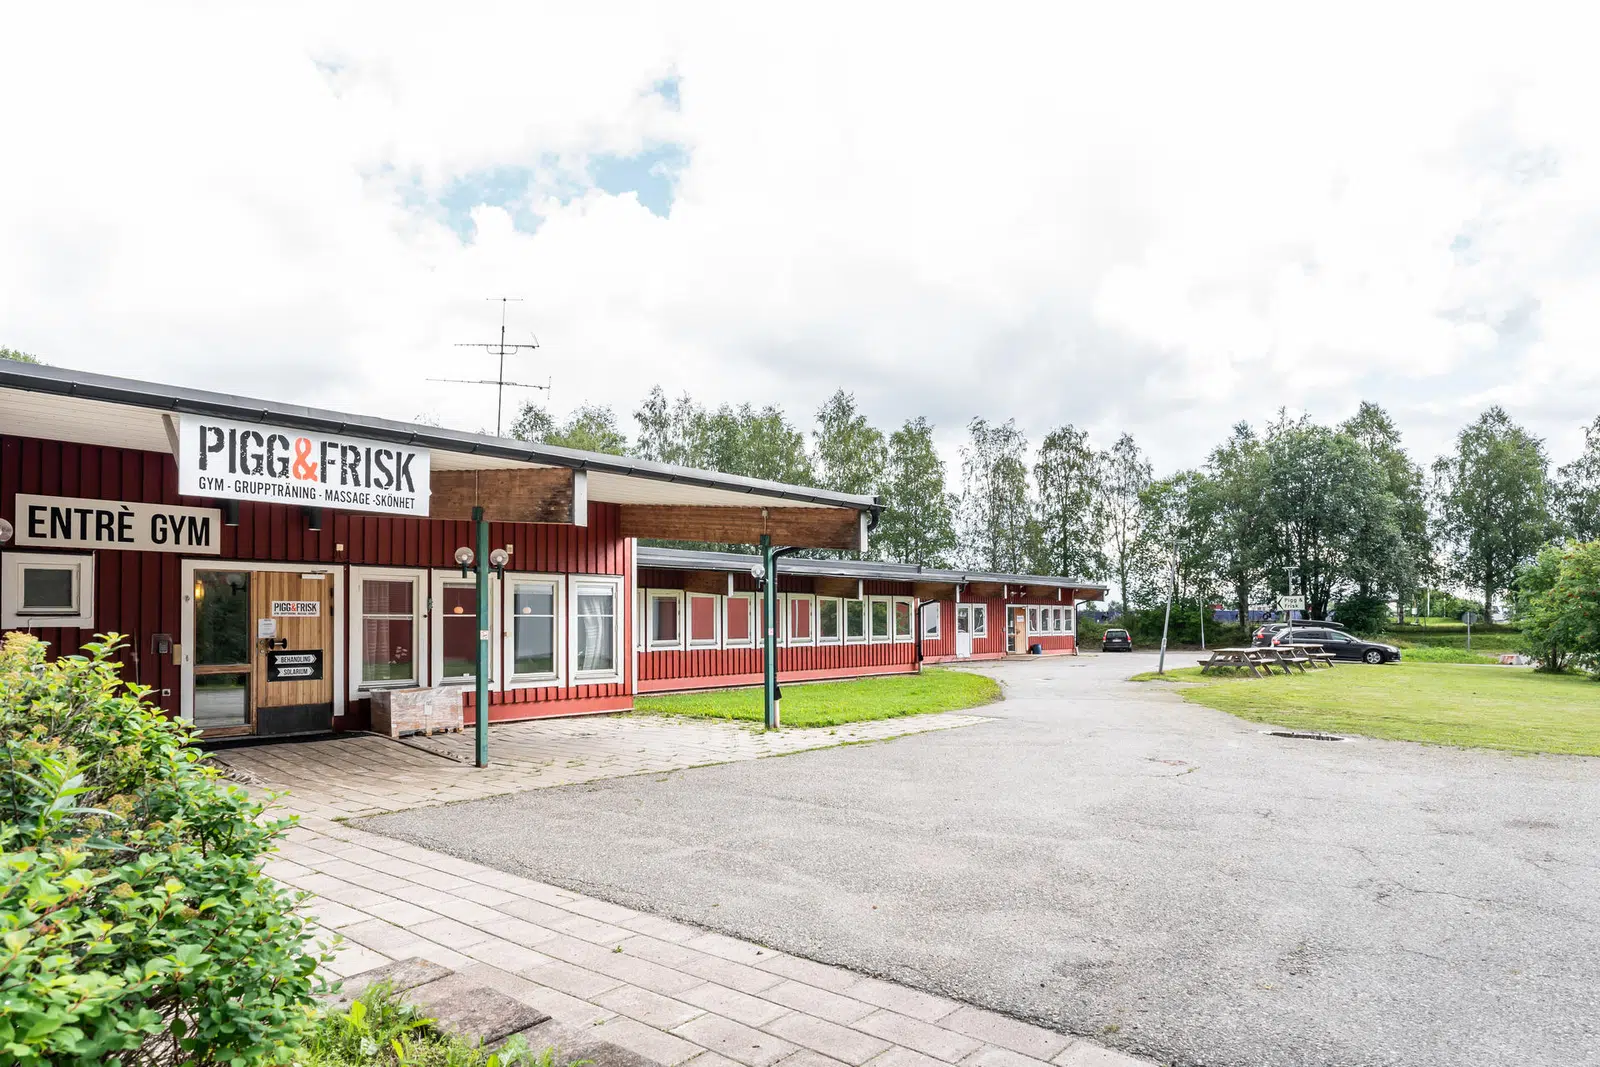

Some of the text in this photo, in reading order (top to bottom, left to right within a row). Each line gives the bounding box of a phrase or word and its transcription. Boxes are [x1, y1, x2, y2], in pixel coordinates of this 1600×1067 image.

[199, 425, 415, 493] PIGG&FRISK
[199, 476, 224, 491] GYM
[234, 480, 316, 499] GRUPPTRÄNING
[325, 489, 370, 505] MASSAGE
[28, 505, 210, 546] ENTRÈ GYM
[274, 603, 317, 612] PIGG&FRISK
